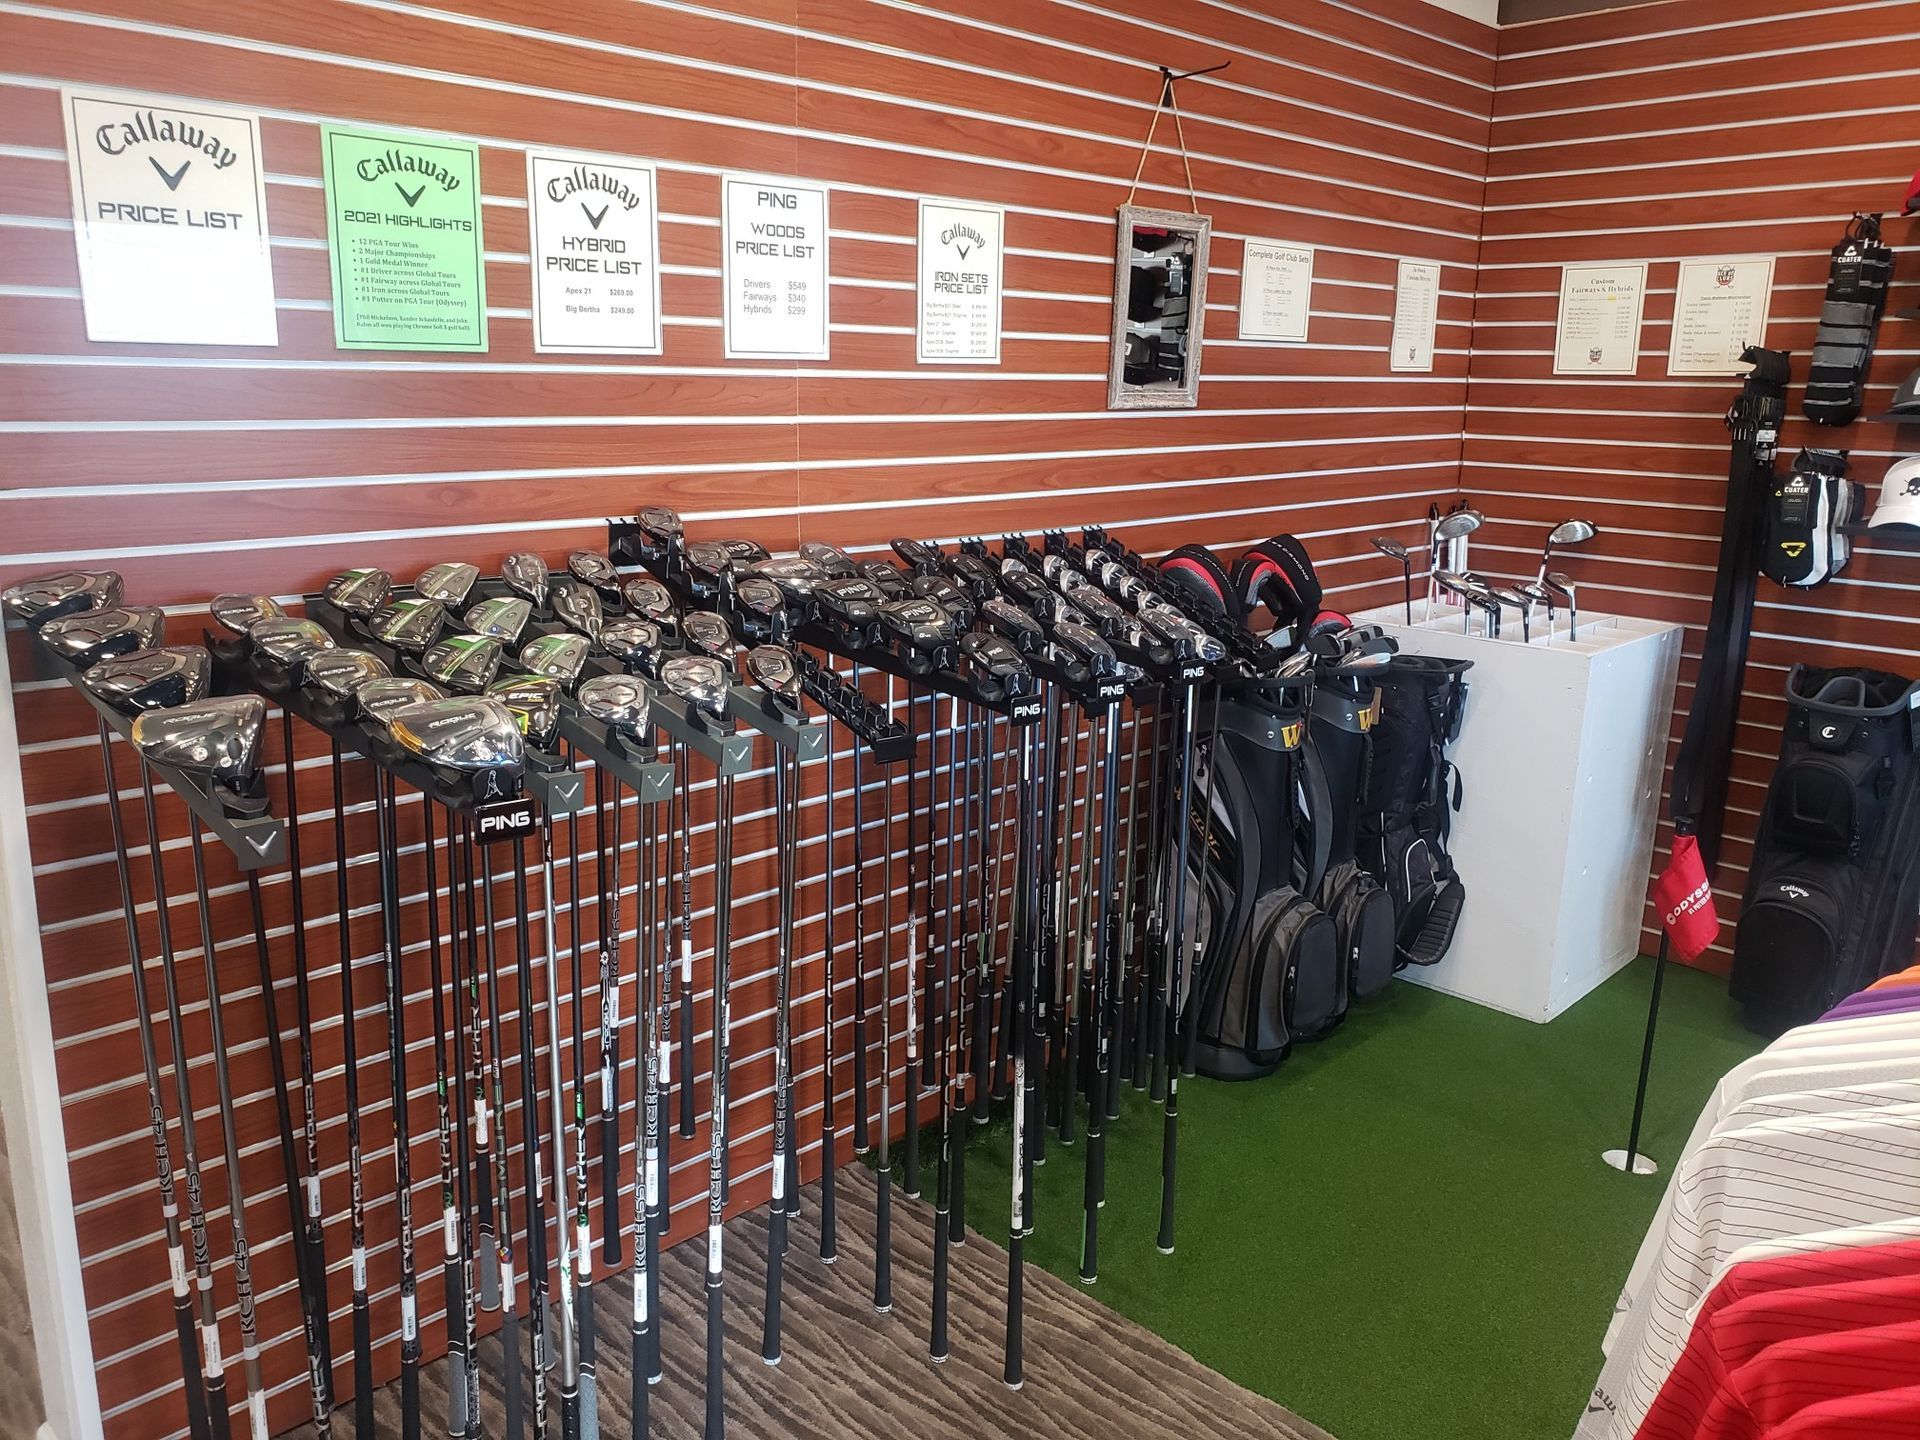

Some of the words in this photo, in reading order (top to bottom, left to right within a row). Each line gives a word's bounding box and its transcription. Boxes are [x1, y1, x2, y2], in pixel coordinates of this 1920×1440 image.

[96, 110, 237, 169] Callaway
[357, 149, 460, 192] Callaway
[547, 165, 640, 211] Callaway
[757, 191, 797, 209] PING
[98, 201, 178, 225] PRICE
[187, 209, 243, 230] LIST
[344, 210, 381, 224] 2021
[385, 213, 472, 232] HIGHLIGHTS
[750, 222, 805, 239] WOODS
[941, 222, 986, 249] Callaway
[384, 240, 401, 248] Tour
[402, 241, 419, 249] Wins
[562, 235, 626, 254] HYBRID
[736, 241, 779, 257] PRICE
[783, 244, 815, 259] LIST
[365, 248, 384, 257] Major
[386, 249, 436, 260] Championships
[1248, 248, 1274, 260] Complete
[1274, 252, 1285, 261] Golf
[1286, 253, 1297, 262] Club
[382, 259, 402, 267] Medal
[404, 260, 428, 268] Winner
[546, 256, 599, 273] PRICE
[604, 260, 642, 275] LIST
[371, 267, 392, 275] Driver
[415, 270, 437, 278] Global
[437, 271, 456, 279] Tours
[934, 271, 959, 282] IRON
[961, 273, 988, 284] SETS
[371, 277, 397, 287] Fairway
[421, 279, 442, 288] Global
[443, 281, 461, 289] Tours
[744, 278, 771, 289] Drivers
[788, 281, 807, 291] $549
[934, 282, 964, 293] PRICE
[966, 284, 989, 295] LIST
[371, 286, 386, 294] Iron
[409, 288, 431, 296] Global
[565, 287, 583, 297] Apex
[609, 288, 634, 297] $269.00
[743, 291, 777, 303] Fairways
[788, 293, 806, 303] $340
[404, 297, 418, 305] PGA
[419, 298, 435, 306] Tour
[436, 299, 467, 308] (Odyssey)
[566, 305, 577, 315] Big
[578, 305, 601, 314] Bertha
[610, 306, 635, 315] $249.00
[744, 304, 773, 316] Hybrids
[787, 305, 806, 315] $299
[1784, 486, 1809, 494] CUATER
[726, 543, 750, 553] ING
[836, 583, 869, 597] PING
[219, 607, 255, 616] ROGUE
[901, 605, 933, 619] PING
[262, 633, 298, 643] ROGUE
[319, 665, 357, 677] ROGUE
[1183, 666, 1205, 680] PING
[508, 692, 544, 700] EPIC
[1100, 684, 1125, 698] PING
[370, 696, 409, 708] ROGUE
[1014, 703, 1040, 719] PING
[427, 712, 477, 729] ROGUE
[1822, 726, 1836, 739] C
[480, 810, 531, 834] PING
[1674, 878, 1710, 916] ODYSS
[1780, 884, 1810, 897] Callaway
[470, 1005, 483, 1080] CYPHER
[647, 1056, 658, 1085] 45
[148, 1086, 156, 1097] A
[151, 1104, 164, 1136] 45
[645, 1089, 658, 1140] RCH
[438, 1103, 453, 1184] CYPHER
[711, 1131, 722, 1159] 55
[186, 1151, 194, 1162] A
[154, 1141, 173, 1195] RCH
[575, 1126, 588, 1207] CYPHER
[186, 1171, 201, 1204] 45
[710, 1162, 722, 1216] RCH
[635, 1184, 647, 1214] 55
[233, 1217, 240, 1229] R
[189, 1209, 210, 1267] RCH
[634, 1219, 647, 1271] RCH
[234, 1237, 248, 1271] 45
[235, 1276, 257, 1336] RCH
[309, 1353, 331, 1439] YPHER
